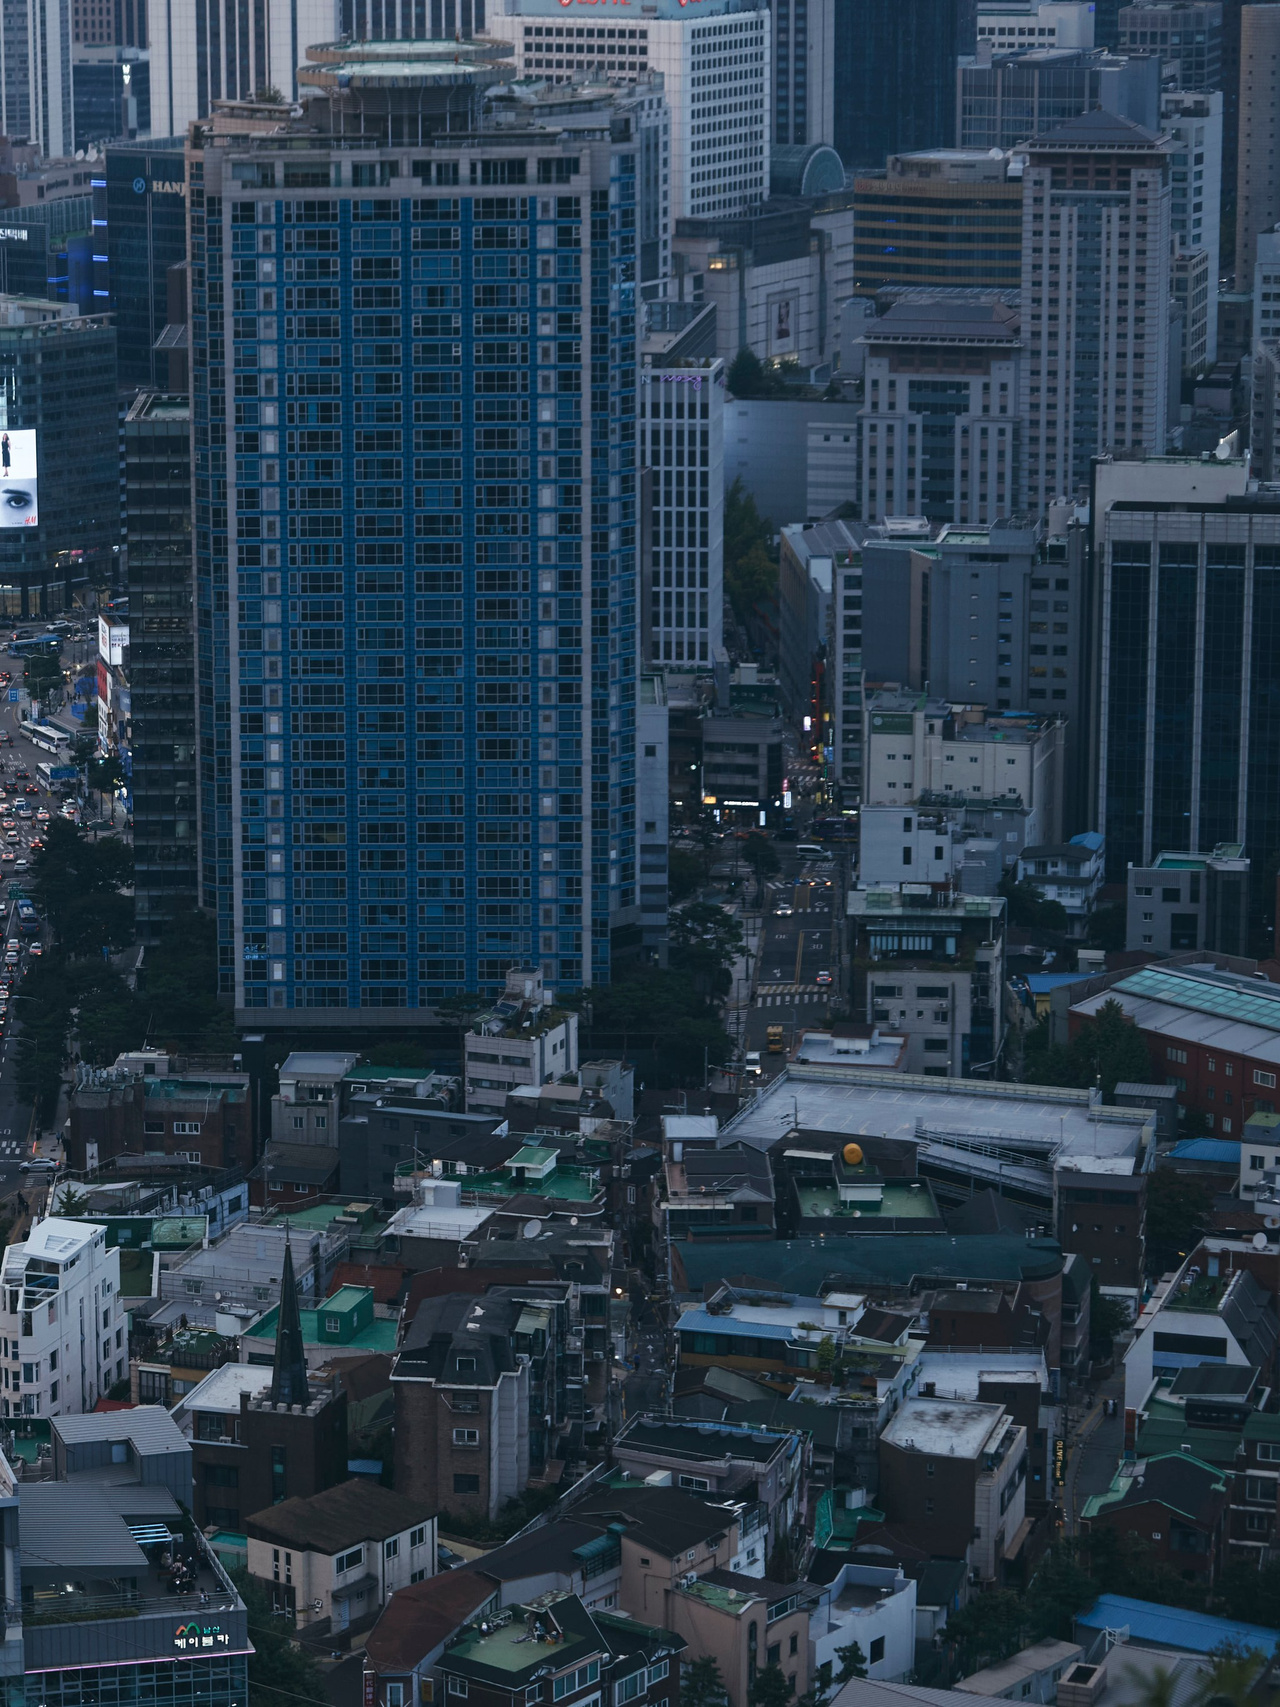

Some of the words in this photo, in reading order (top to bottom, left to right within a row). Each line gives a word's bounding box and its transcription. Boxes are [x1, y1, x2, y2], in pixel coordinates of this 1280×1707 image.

[361, 74, 473, 88] PLATINUM
[1056, 1440, 1064, 1461] OLIVE
[203, 1626, 220, 1635] 남산
[174, 1633, 230, 1649] 케이블카
